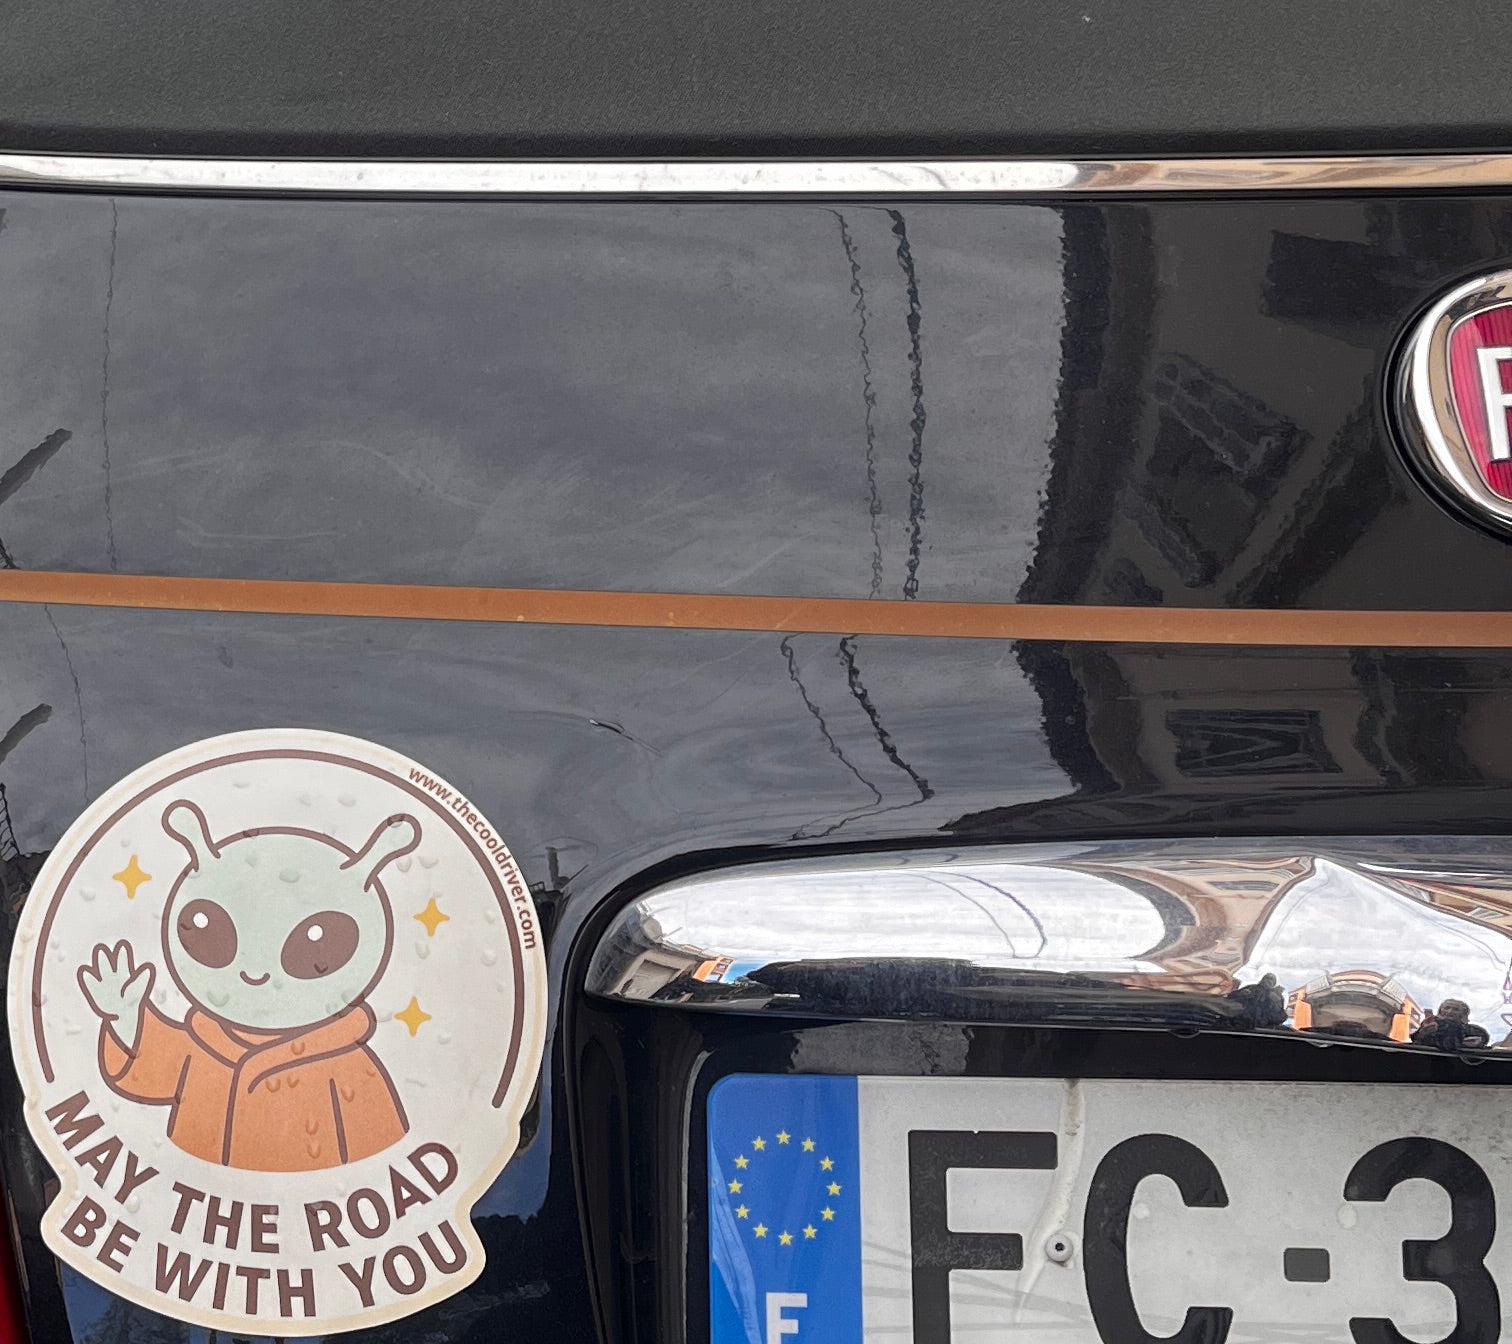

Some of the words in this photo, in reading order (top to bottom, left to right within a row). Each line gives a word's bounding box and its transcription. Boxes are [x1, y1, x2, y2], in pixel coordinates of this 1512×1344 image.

[408, 767, 537, 950] www.thecooldriver.com
[45, 1090, 159, 1206] MAY
[170, 1182, 280, 1254] THE
[304, 1141, 459, 1252] ROAD
[60, 1201, 142, 1273] BE
[154, 1244, 317, 1318] WITH
[339, 1220, 468, 1309] YOU
